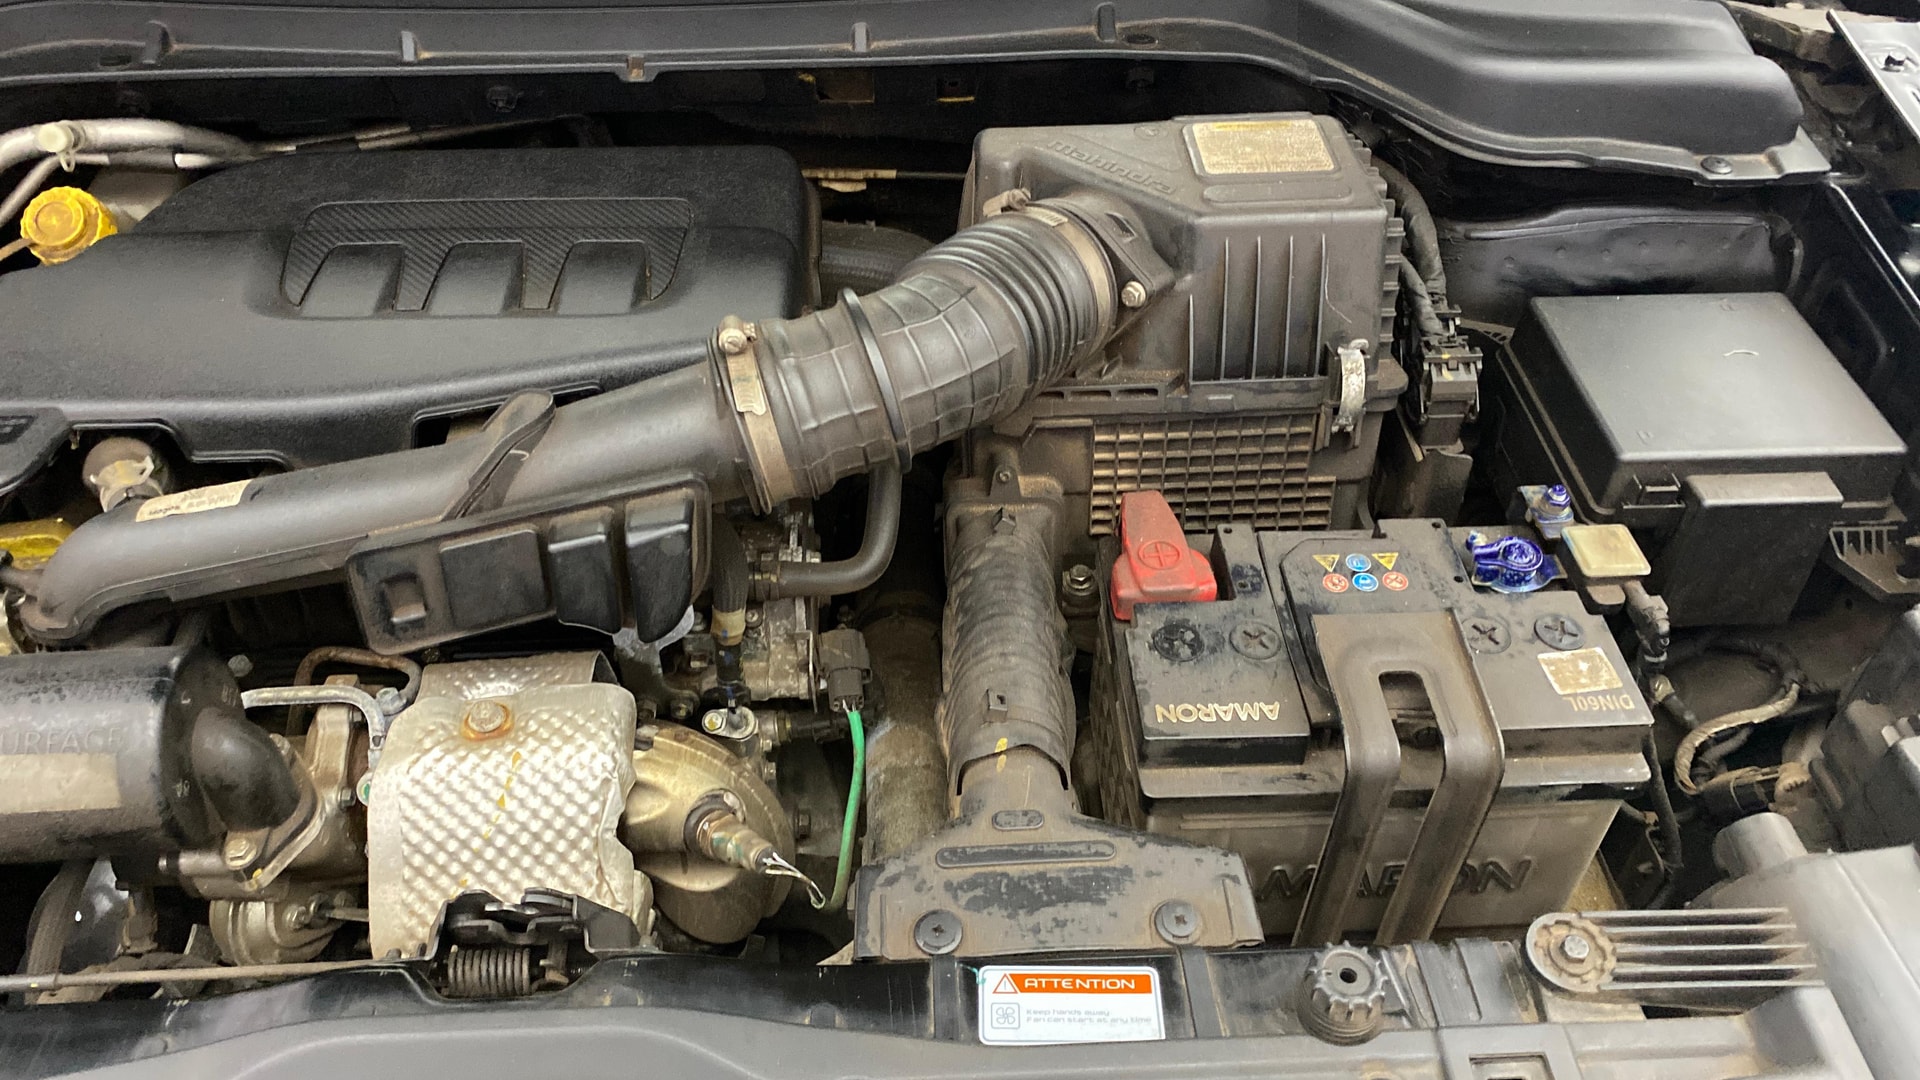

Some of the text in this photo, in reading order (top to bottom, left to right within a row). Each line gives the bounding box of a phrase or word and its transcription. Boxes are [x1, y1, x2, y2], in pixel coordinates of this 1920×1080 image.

[1562, 694, 1636, 712] DIN60L
[1155, 701, 1280, 723] AMARON
[1024, 978, 1136, 990] ATTENTION
[1026, 1008, 1110, 1017] Keep hands away
[1026, 1016, 1046, 1024] Fan
[1067, 1016, 1094, 1024] start
[1110, 1016, 1129, 1025] any
[1130, 1015, 1153, 1024] time
